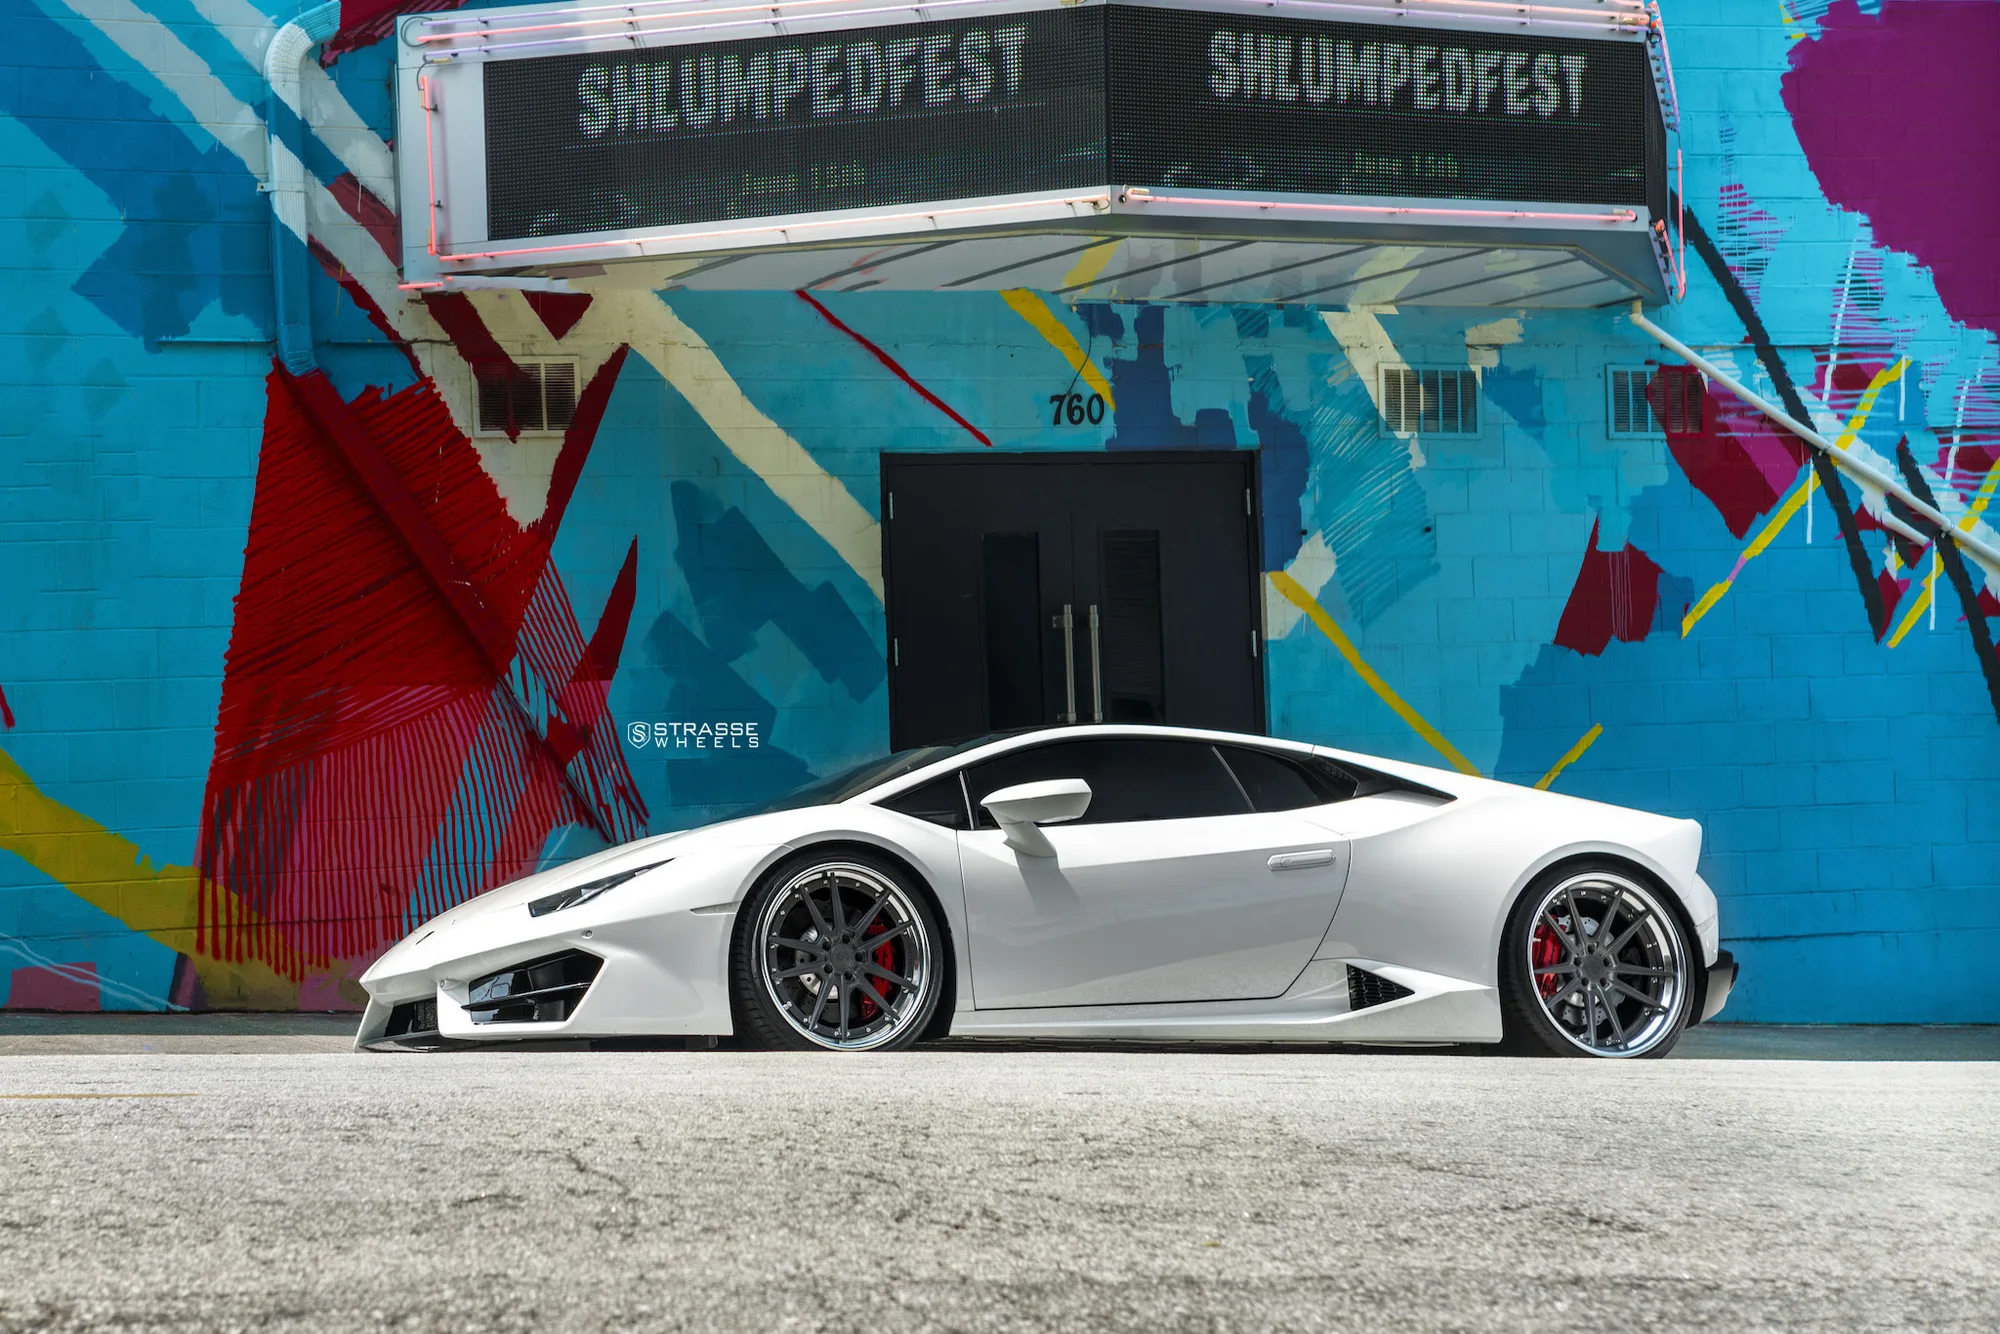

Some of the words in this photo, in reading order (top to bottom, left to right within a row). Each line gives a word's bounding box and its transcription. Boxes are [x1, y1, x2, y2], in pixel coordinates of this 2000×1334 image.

[578, 22, 1030, 138] SHLUMPEDFEST
[1207, 28, 1588, 119] SHLUMPEDFEST
[1049, 393, 1105, 426] 760
